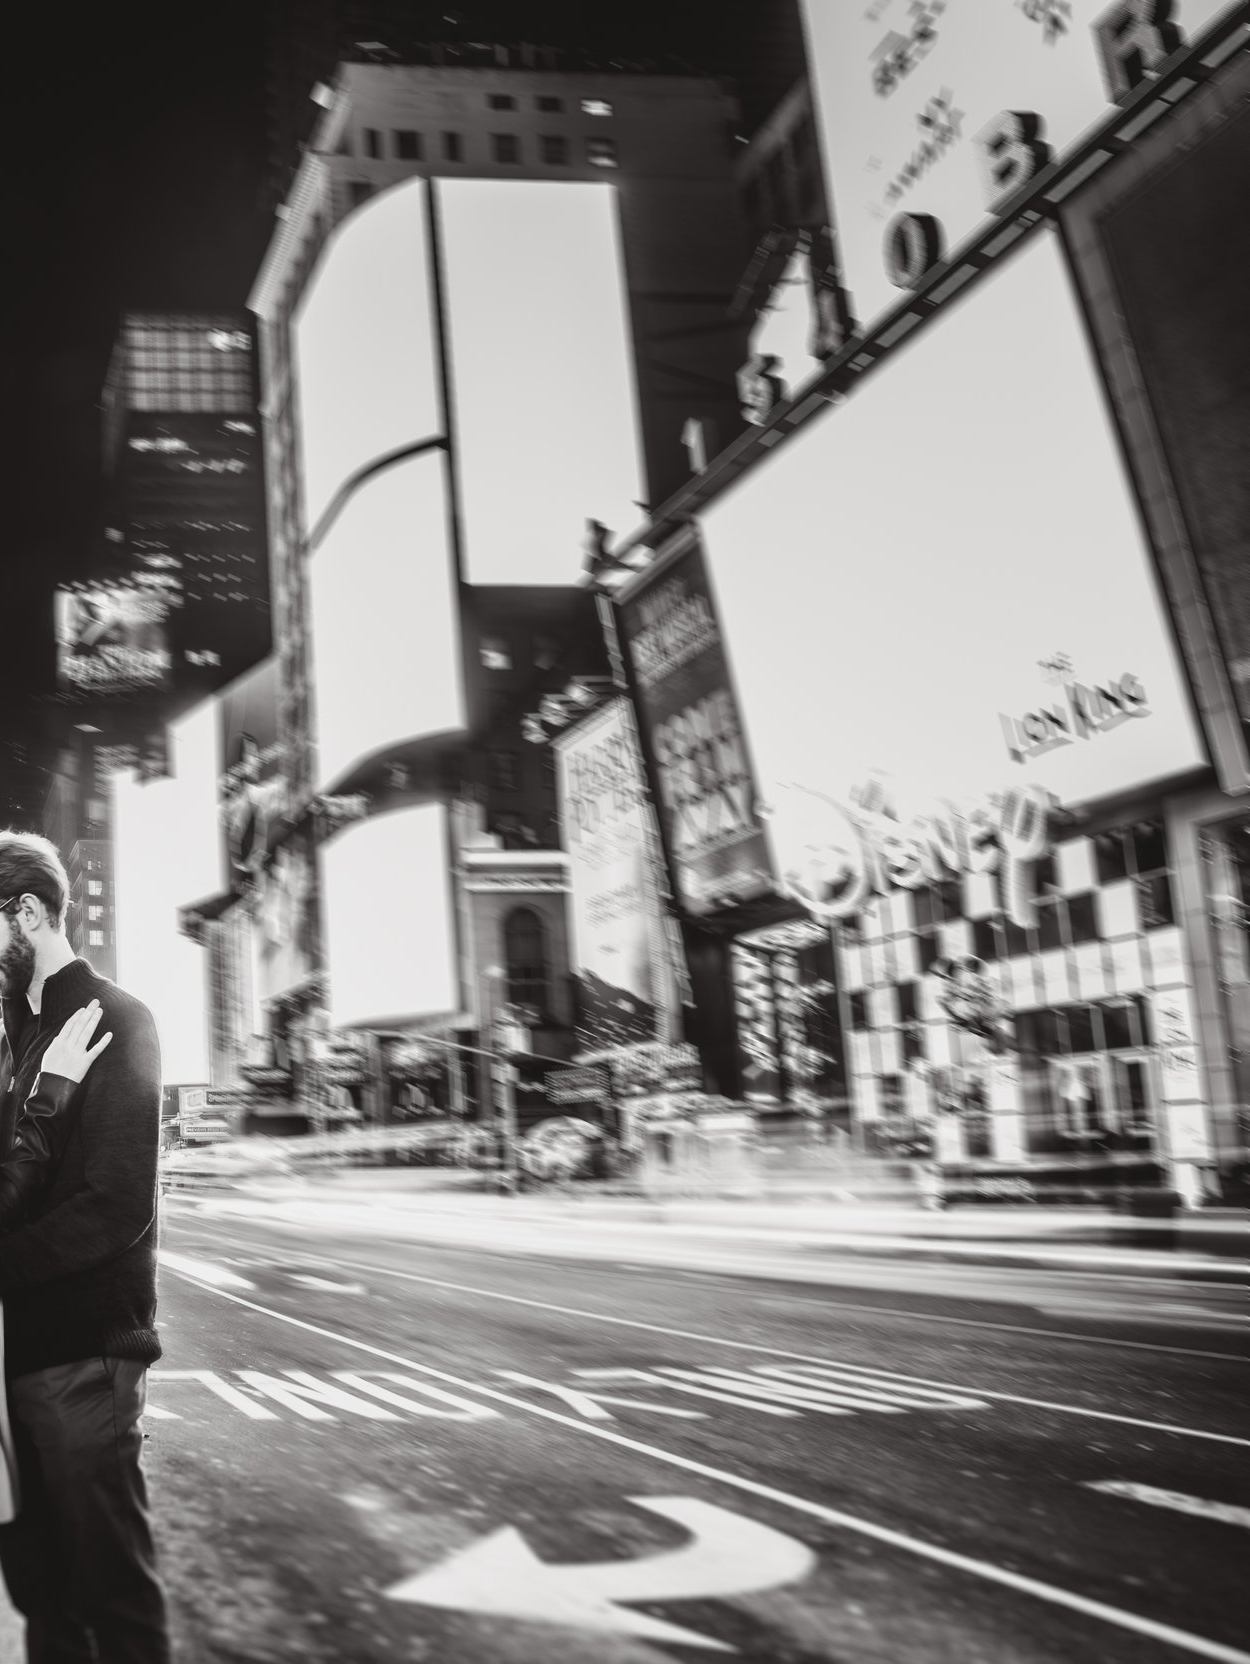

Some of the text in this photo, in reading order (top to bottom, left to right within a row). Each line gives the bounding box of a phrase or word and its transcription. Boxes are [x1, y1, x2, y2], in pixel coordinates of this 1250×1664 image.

[998, 672, 1152, 765] LION KING
[143, 1369, 500, 1421] ONL
